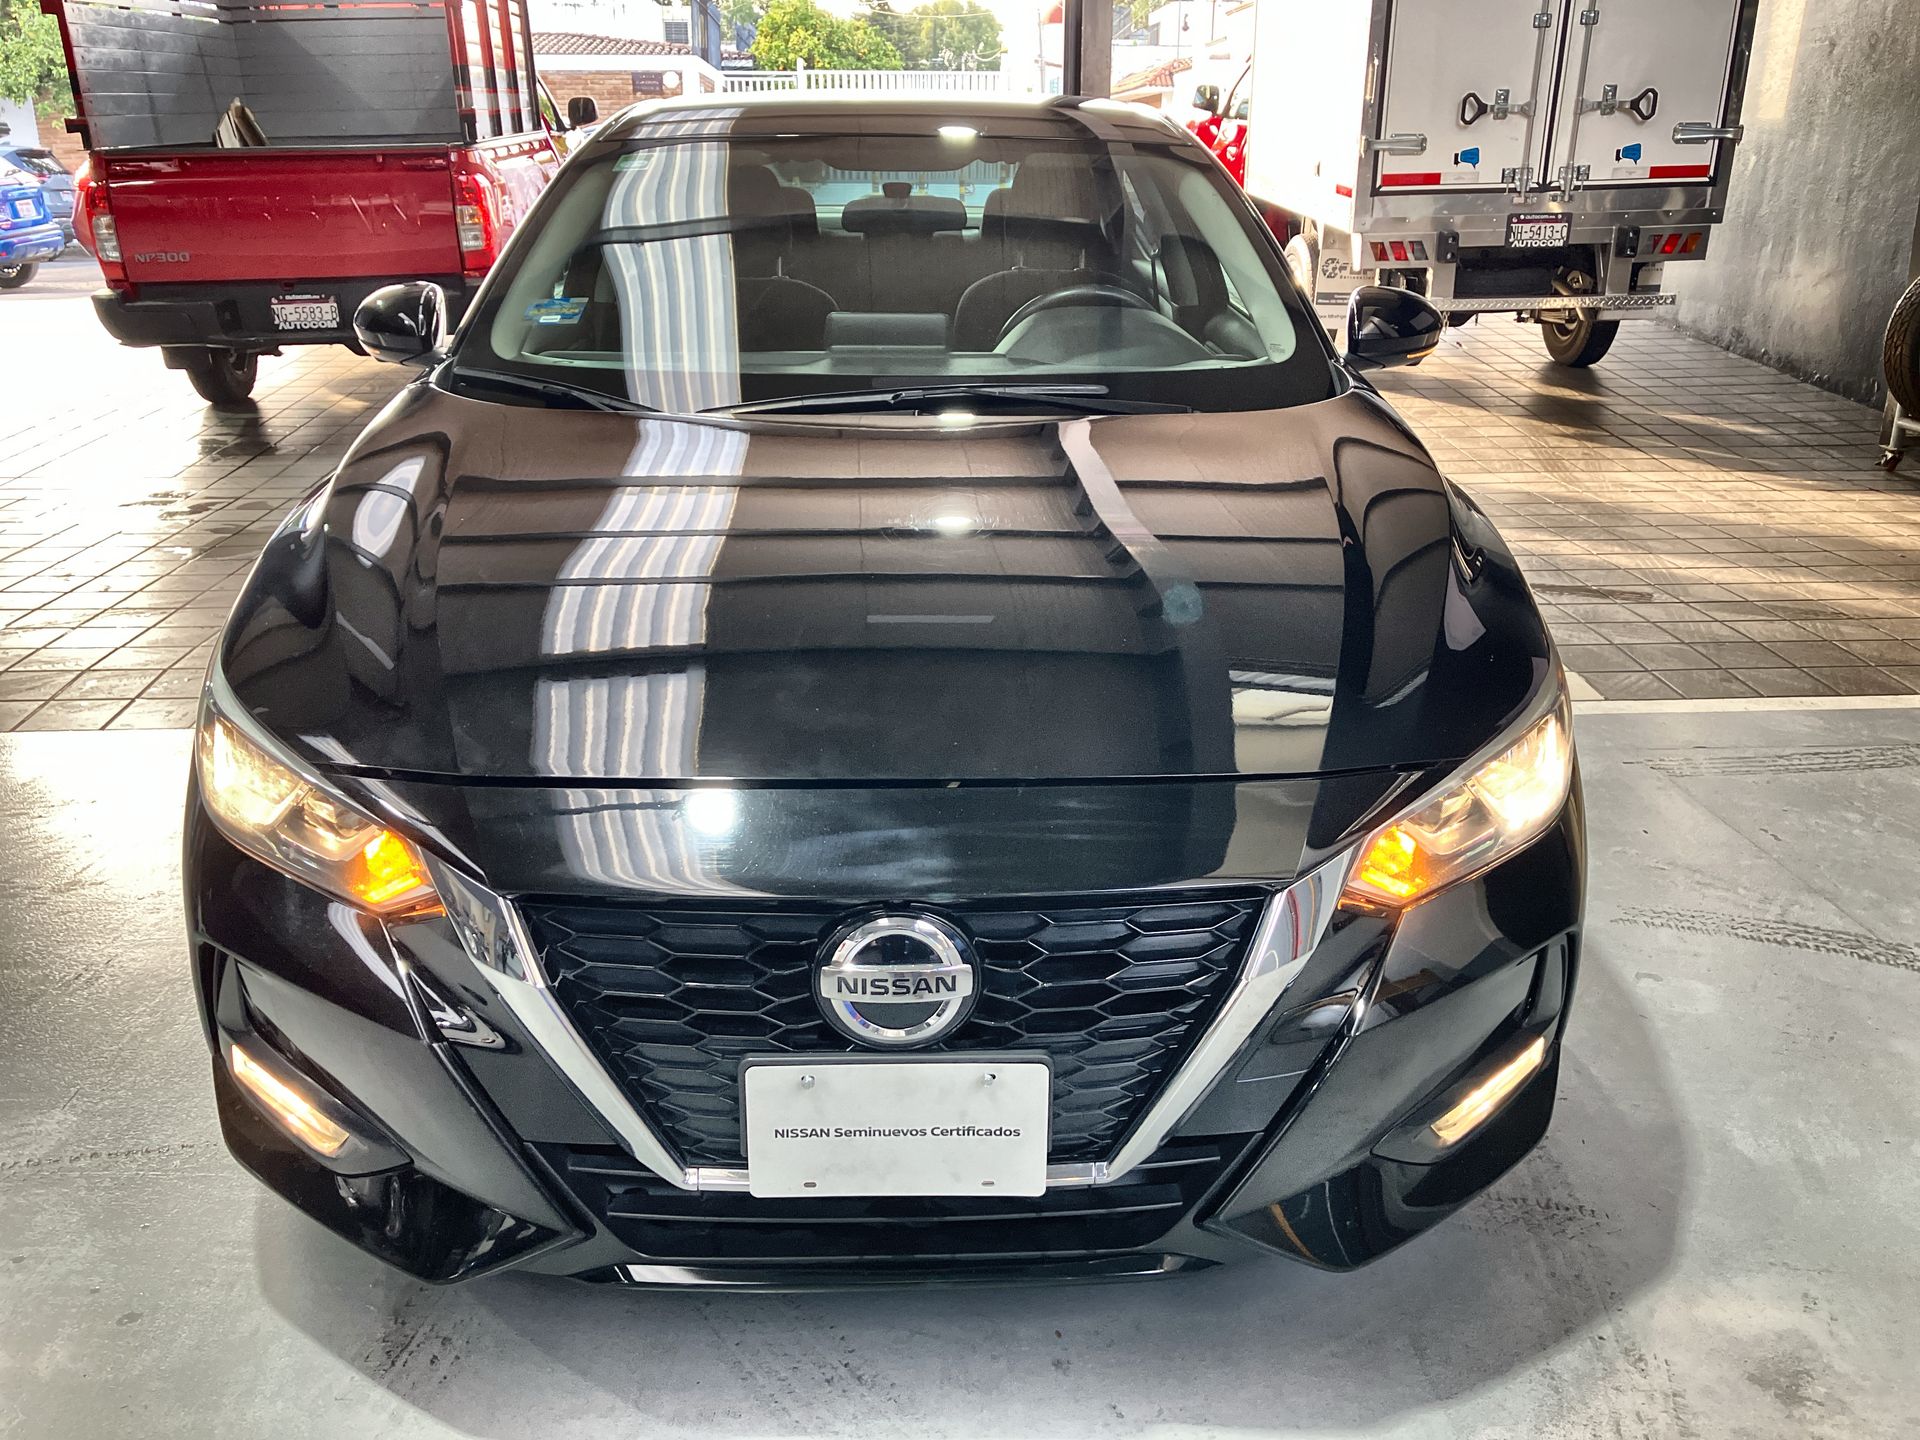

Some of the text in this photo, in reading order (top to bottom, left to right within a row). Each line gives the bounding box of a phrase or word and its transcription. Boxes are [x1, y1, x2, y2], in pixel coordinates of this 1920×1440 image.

[1511, 239, 1564, 248] AUTOCOM
[134, 252, 190, 263] NP300
[278, 320, 338, 331] AUTOCOM
[837, 974, 957, 996] NISSAN
[774, 1125, 1021, 1139] NISSAN Seminuevos Certificados
